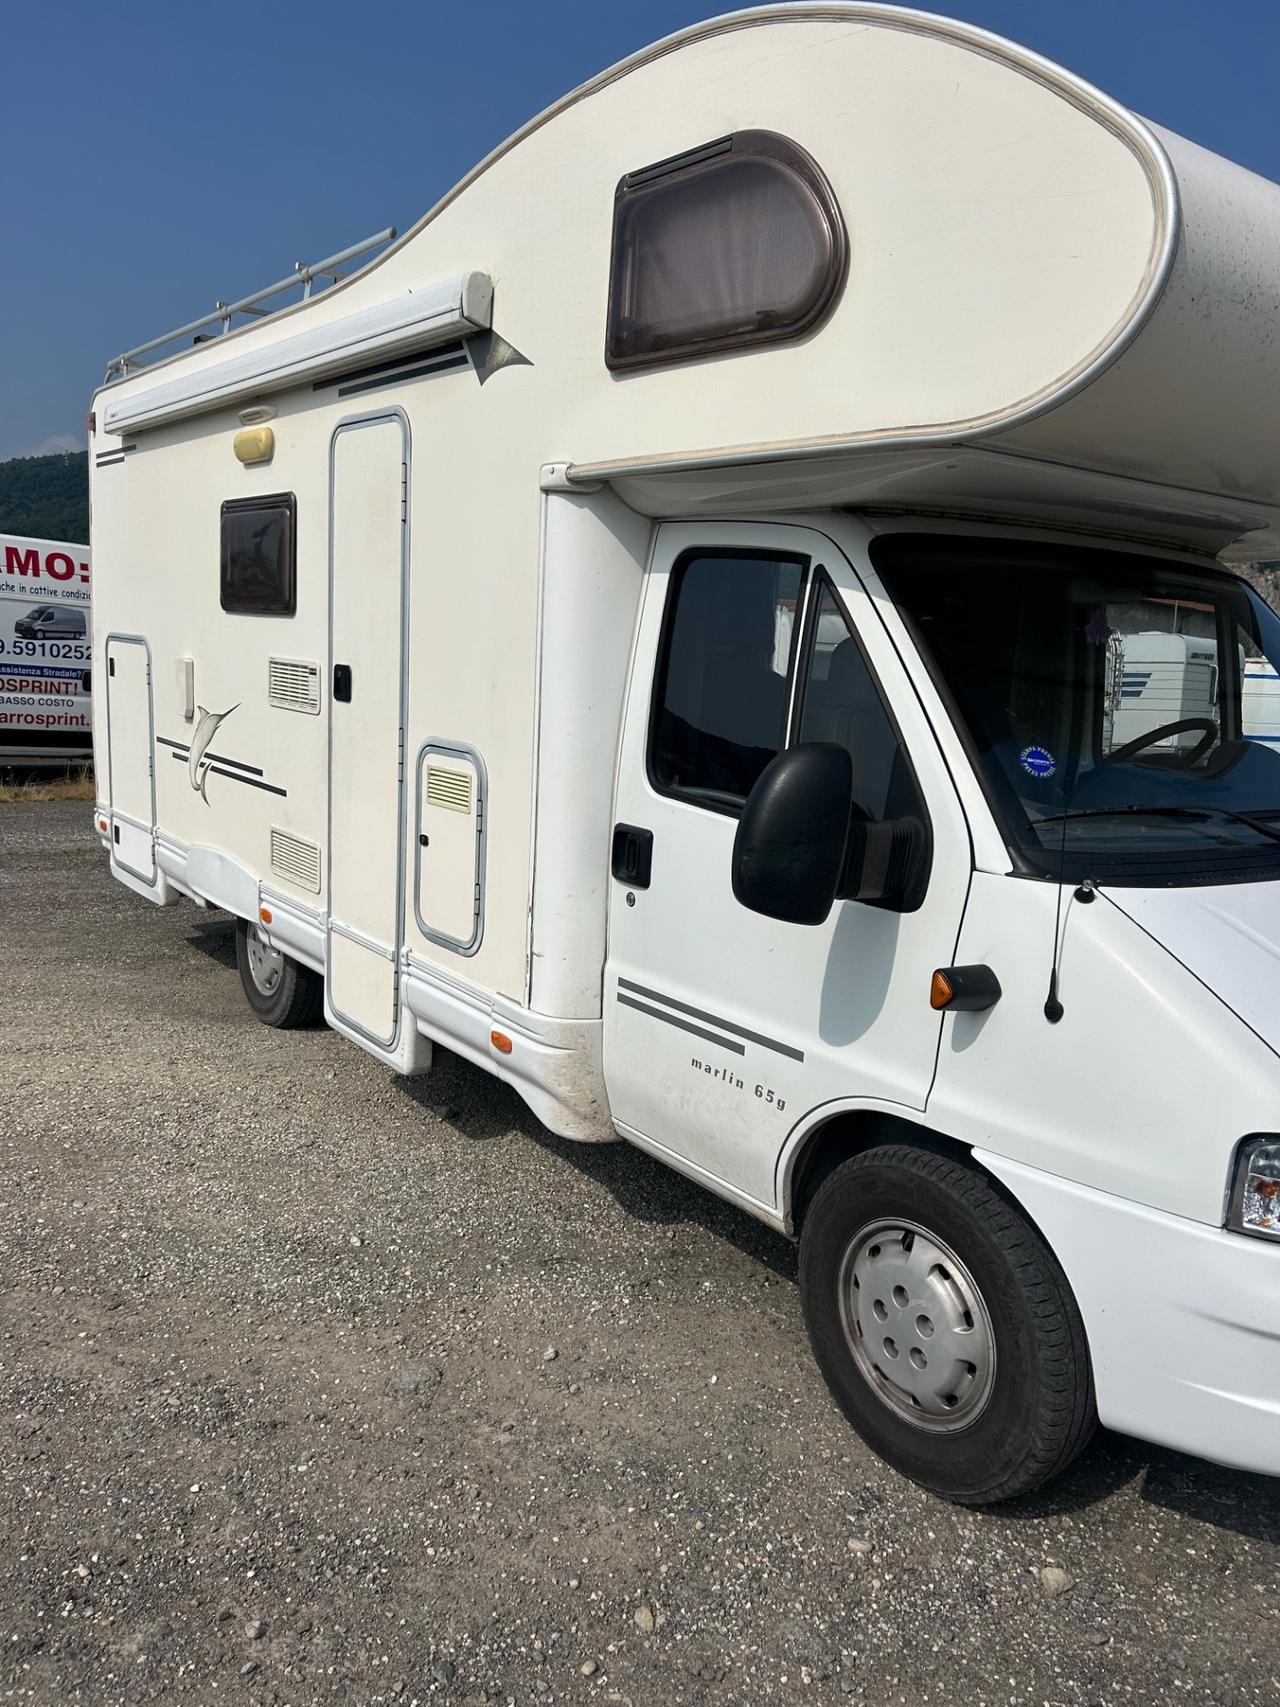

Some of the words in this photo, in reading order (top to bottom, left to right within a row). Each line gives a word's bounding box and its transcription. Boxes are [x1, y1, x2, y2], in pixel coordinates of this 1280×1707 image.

[0, 546, 90, 583] MO:
[0, 581, 15, 592] che
[19, 583, 26, 593] in
[30, 587, 58, 596] cattive
[0, 666, 41, 675] ssistenza
[43, 668, 82, 678] Stradale?
[38, 698, 74, 707] COSTO
[691, 1058, 744, 1089] marlin
[754, 1084, 786, 1111] 65g
